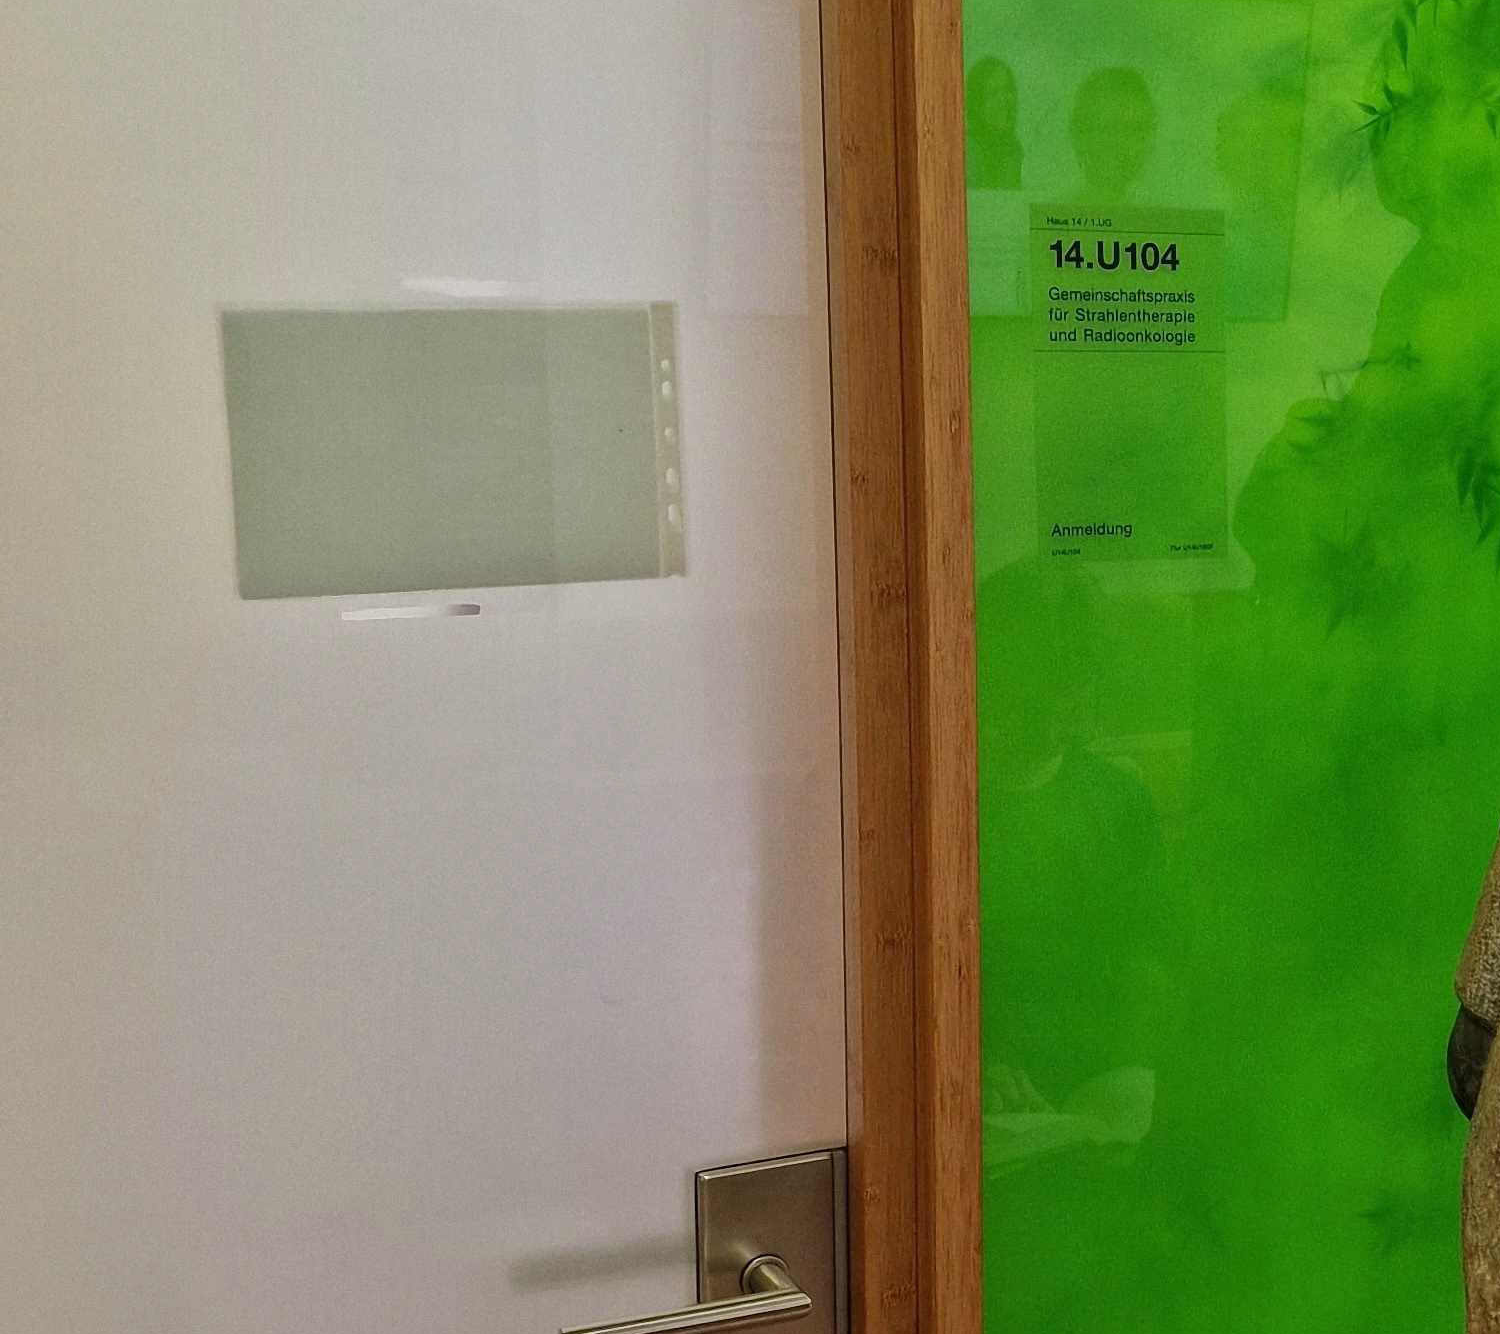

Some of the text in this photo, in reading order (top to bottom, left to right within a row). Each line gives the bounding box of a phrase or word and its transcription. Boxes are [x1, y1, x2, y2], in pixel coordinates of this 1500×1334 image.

[1046, 216, 1069, 226] Haus
[1072, 217, 1082, 227] 14
[1091, 218, 1112, 227] 1.UG
[1049, 239, 1180, 271] 14.U104
[1048, 286, 1195, 305] Gemeinschaftspraxis
[1048, 308, 1195, 326] für Strahlentherapie
[1049, 329, 1196, 346] und Radioonkologie
[1051, 522, 1133, 537] Anmeldung
